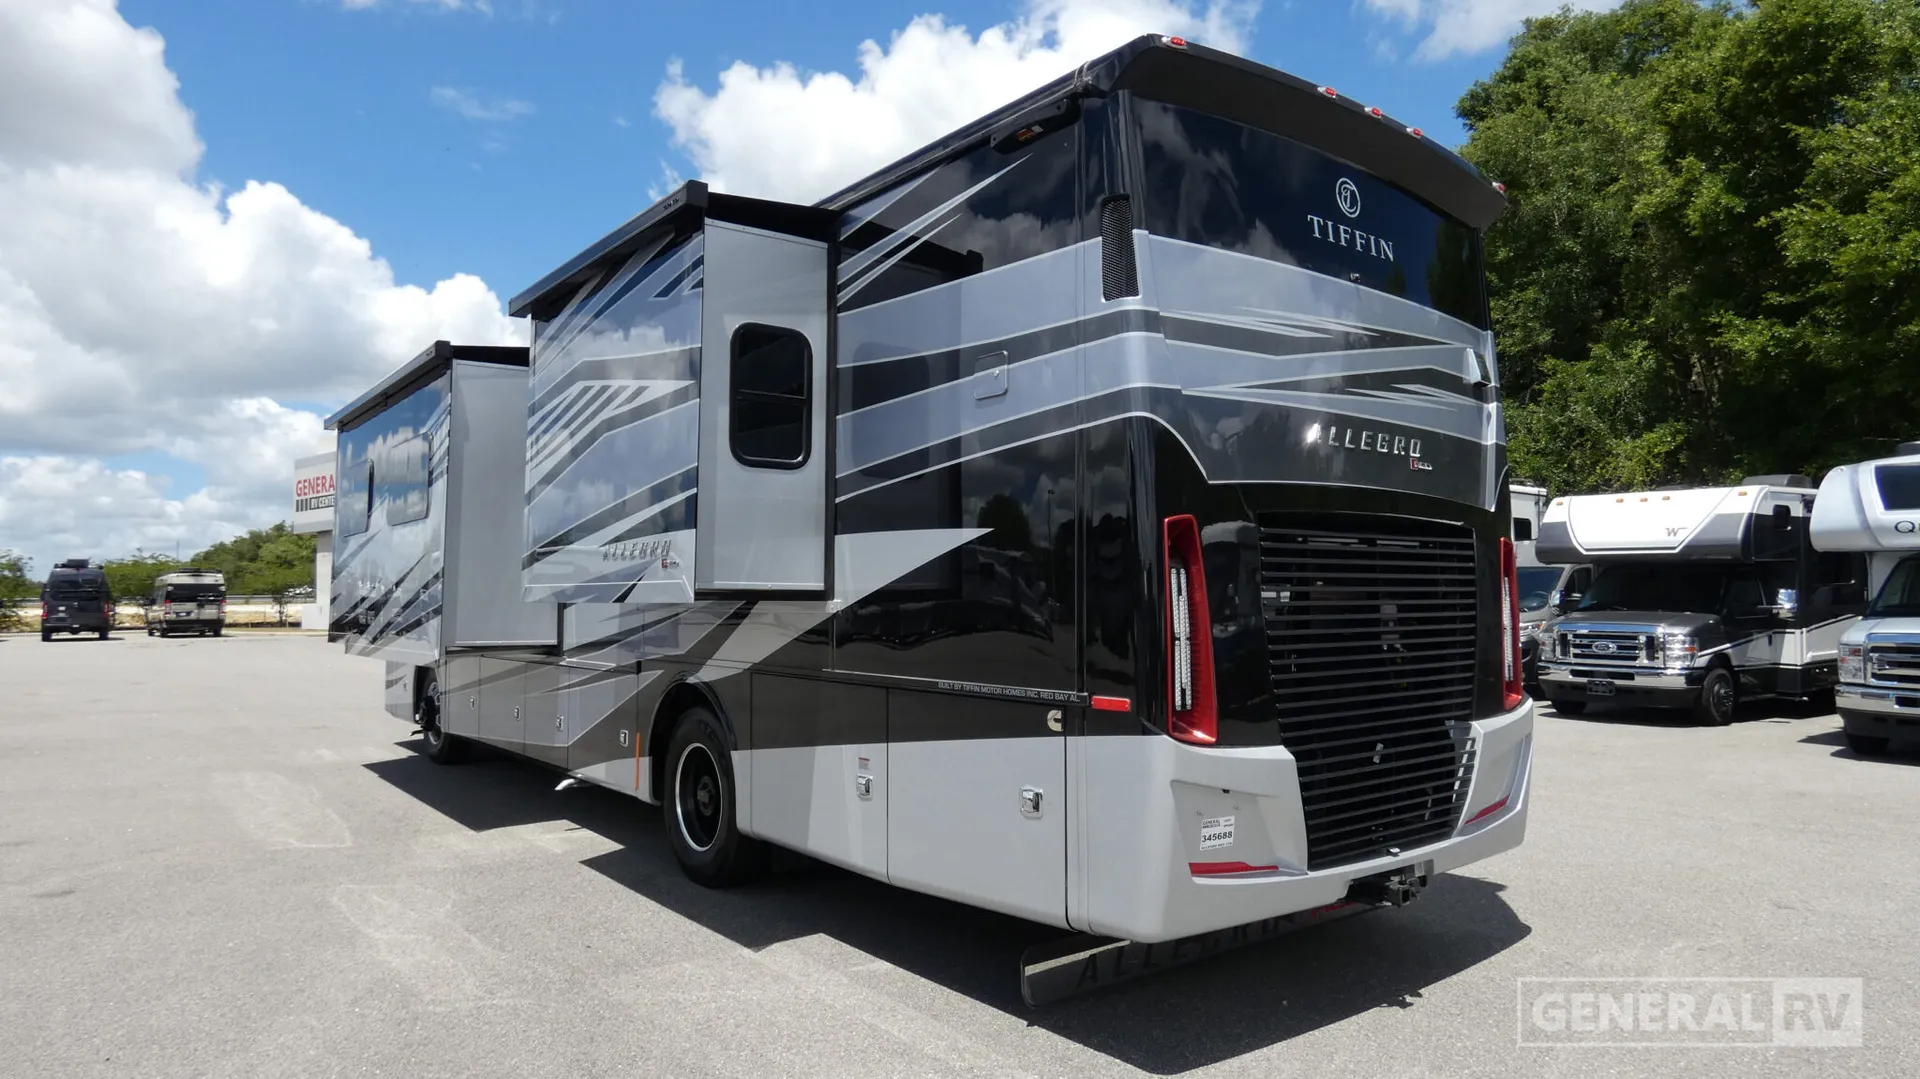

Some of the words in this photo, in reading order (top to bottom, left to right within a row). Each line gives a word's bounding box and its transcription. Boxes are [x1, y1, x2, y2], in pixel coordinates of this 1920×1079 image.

[1307, 214, 1394, 262] TIFFIN
[1894, 520, 1920, 534] Q
[938, 681, 954, 689] BUILT
[963, 684, 980, 693] TIFFIN
[981, 686, 1002, 695] MOTOR
[1003, 688, 1026, 697] HOMES
[1040, 692, 1054, 700] RED
[1055, 693, 1069, 702] BAY
[1201, 831, 1232, 843] 345688
